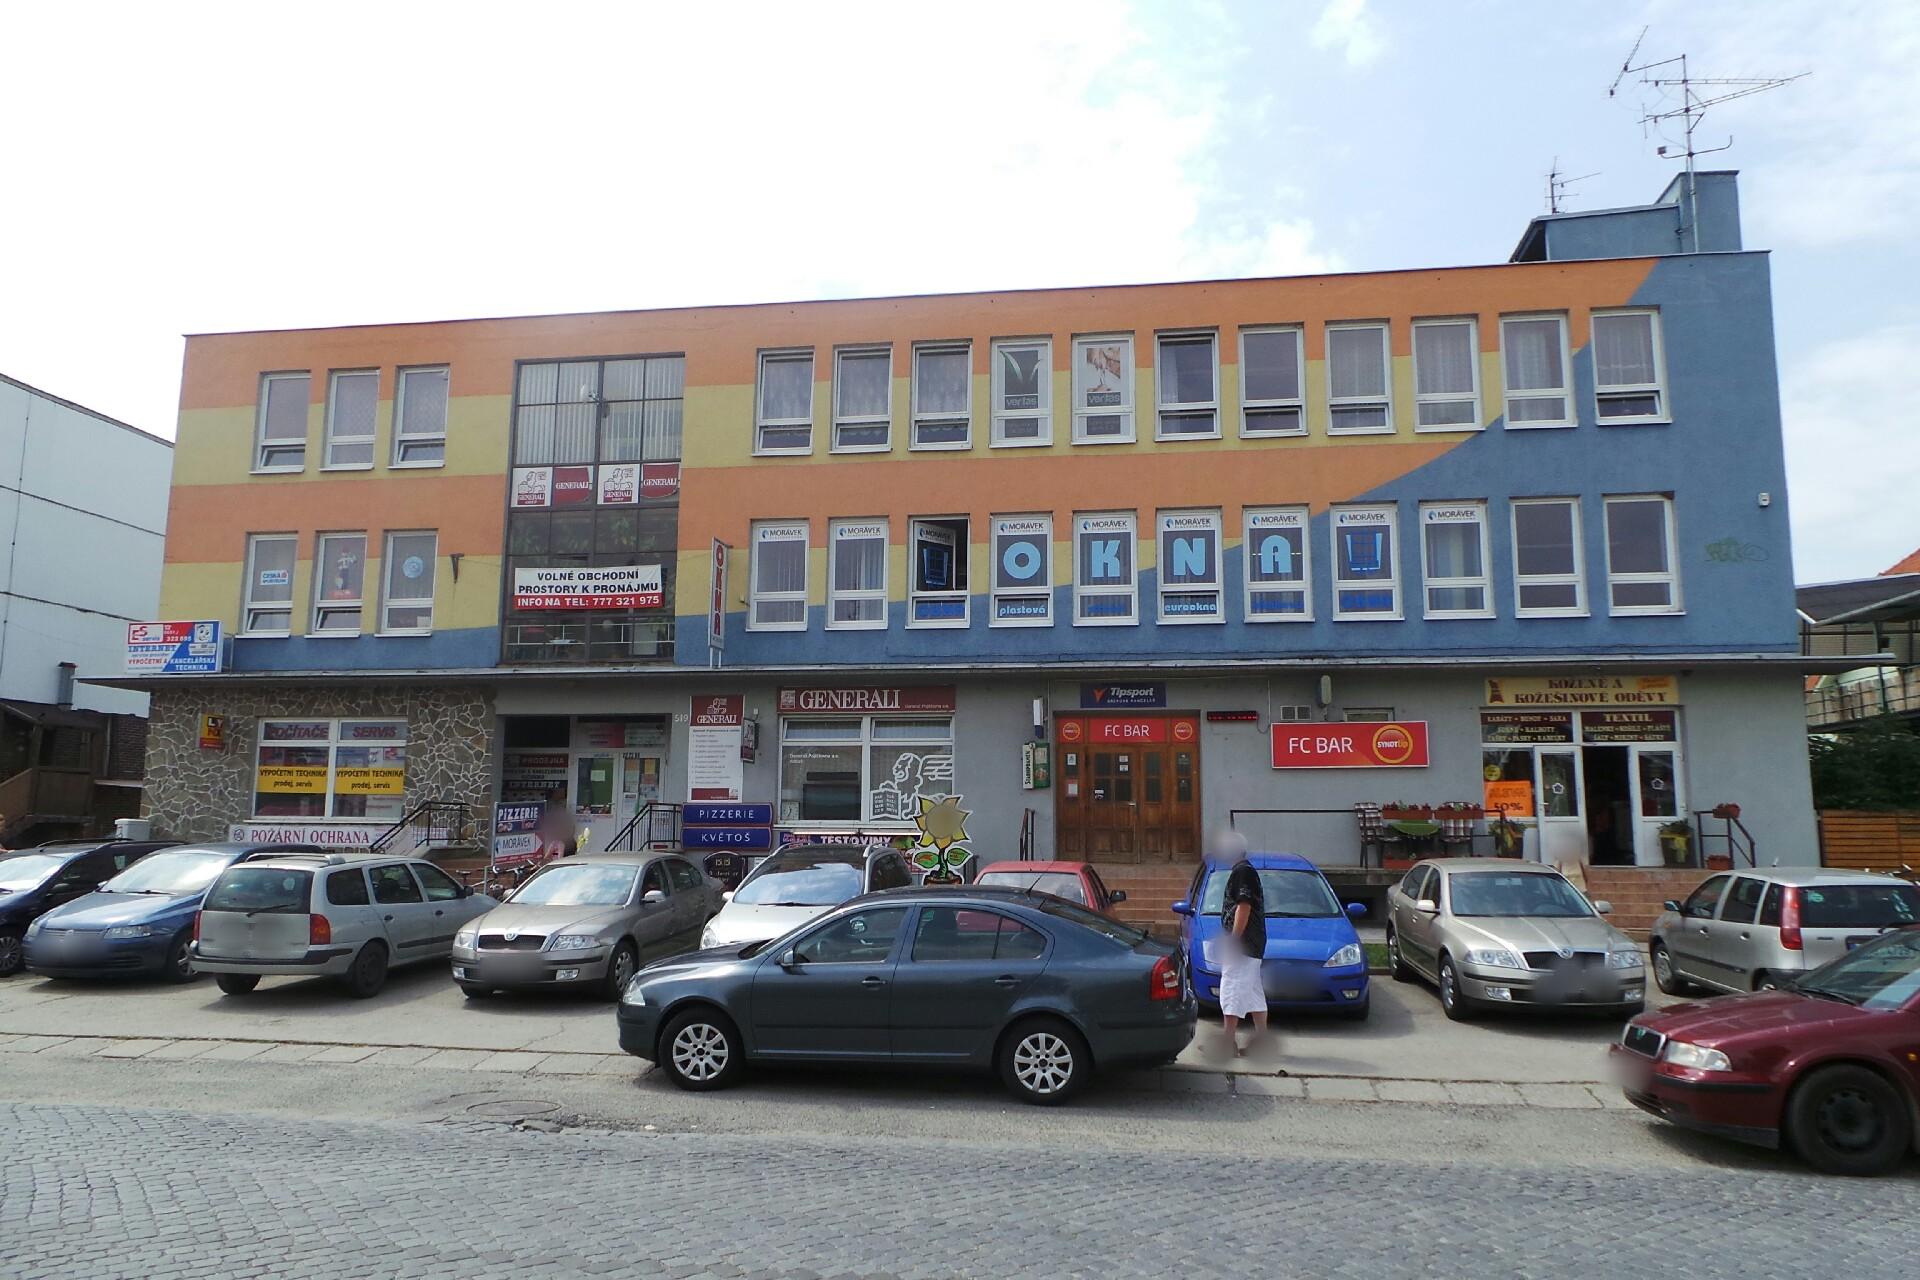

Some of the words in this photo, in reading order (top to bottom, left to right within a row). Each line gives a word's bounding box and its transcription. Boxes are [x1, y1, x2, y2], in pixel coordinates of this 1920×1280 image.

[555, 482, 589, 490] GENERALI
[643, 478, 677, 487] GENERALI
[604, 490, 632, 498] GENERALI
[1261, 514, 1298, 524] MORÁVEK
[1348, 512, 1385, 522] MORÁVEK
[1437, 509, 1475, 519] MORÁVEK
[1009, 522, 1043, 530] MORÁVEK
[1092, 520, 1127, 529] MORÁVEK
[1174, 517, 1211, 526] MORÁVEK
[769, 528, 802, 537] MORÁVEK
[847, 526, 881, 534] MORÁVEK
[537, 570, 574, 581] VOLNÉ
[577, 568, 639, 581] OBCHODNÍ
[518, 585, 577, 594] PROSTORY
[581, 585, 590, 593] K
[593, 582, 658, 593] PRONÁJMU
[517, 598, 545, 606] INFO
[545, 598, 560, 606] NA
[564, 598, 589, 606] TEL:
[592, 597, 612, 605] 777
[616, 597, 635, 605] 321
[639, 596, 660, 604] 975
[999, 604, 1046, 617] plastová
[1164, 601, 1217, 613] eurookna
[1111, 687, 1154, 699] Tipsport
[799, 689, 901, 710] GENERALI
[674, 713, 689, 723] 519
[696, 714, 737, 724] GENERALI
[1605, 713, 1653, 722] TEXTIL
[268, 724, 329, 739] POČÍTAČE
[352, 726, 398, 738] SERVIS
[1104, 724, 1121, 737] FC
[1123, 724, 1150, 737] BAR
[1288, 737, 1312, 755] FC
[1315, 737, 1354, 754] BAR
[260, 769, 294, 777] VÝPOČETNÍ
[295, 769, 327, 777] TECHNIKA
[336, 769, 370, 777] VÝPOČETNÍ
[372, 769, 404, 777] TECHNIKA
[699, 809, 755, 820] PIZZERIE
[251, 827, 306, 845] POŽÁRNÍ
[310, 828, 370, 845] OCHRANA
[701, 830, 751, 843] KVĚTOŠ
